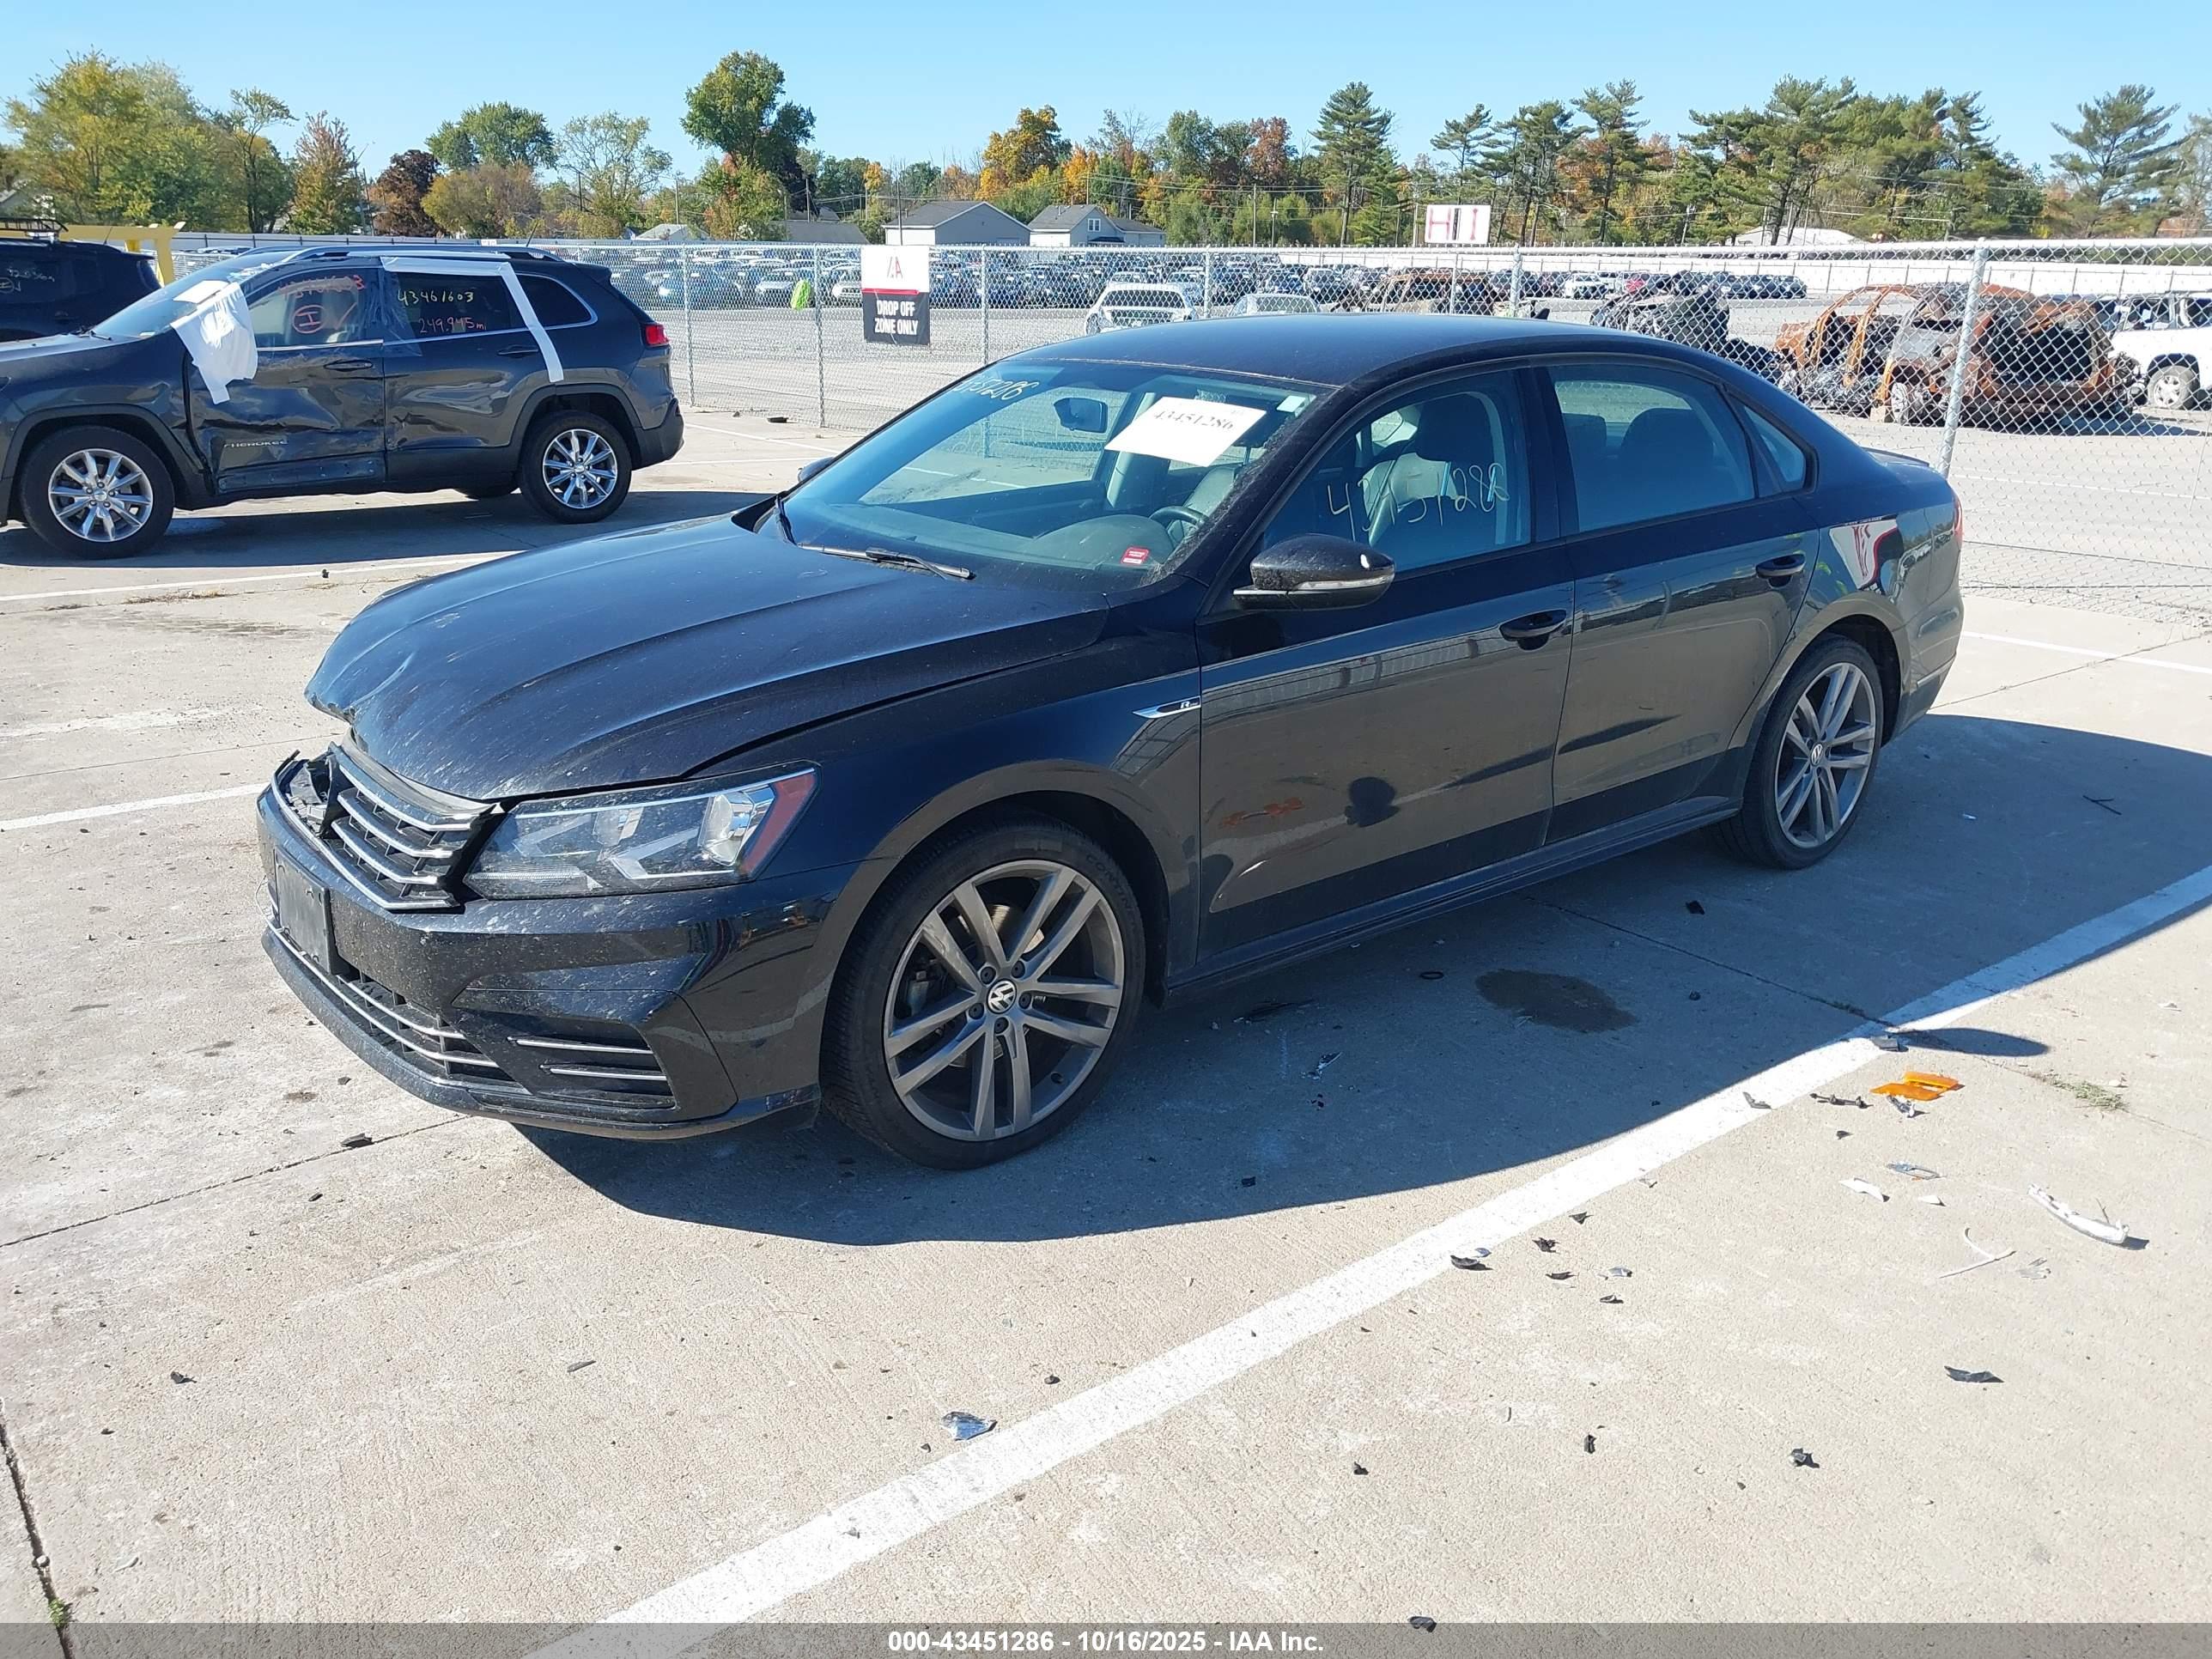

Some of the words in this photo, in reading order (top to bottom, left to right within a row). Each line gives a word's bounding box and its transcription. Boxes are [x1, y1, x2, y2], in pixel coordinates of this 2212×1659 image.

[398, 289, 473, 306] 43461603
[876, 300, 899, 316] DROP
[900, 301, 915, 317] OFF
[874, 319, 896, 334] ZONE
[896, 319, 919, 335] ONLY
[1153, 410, 1234, 430] 43451286
